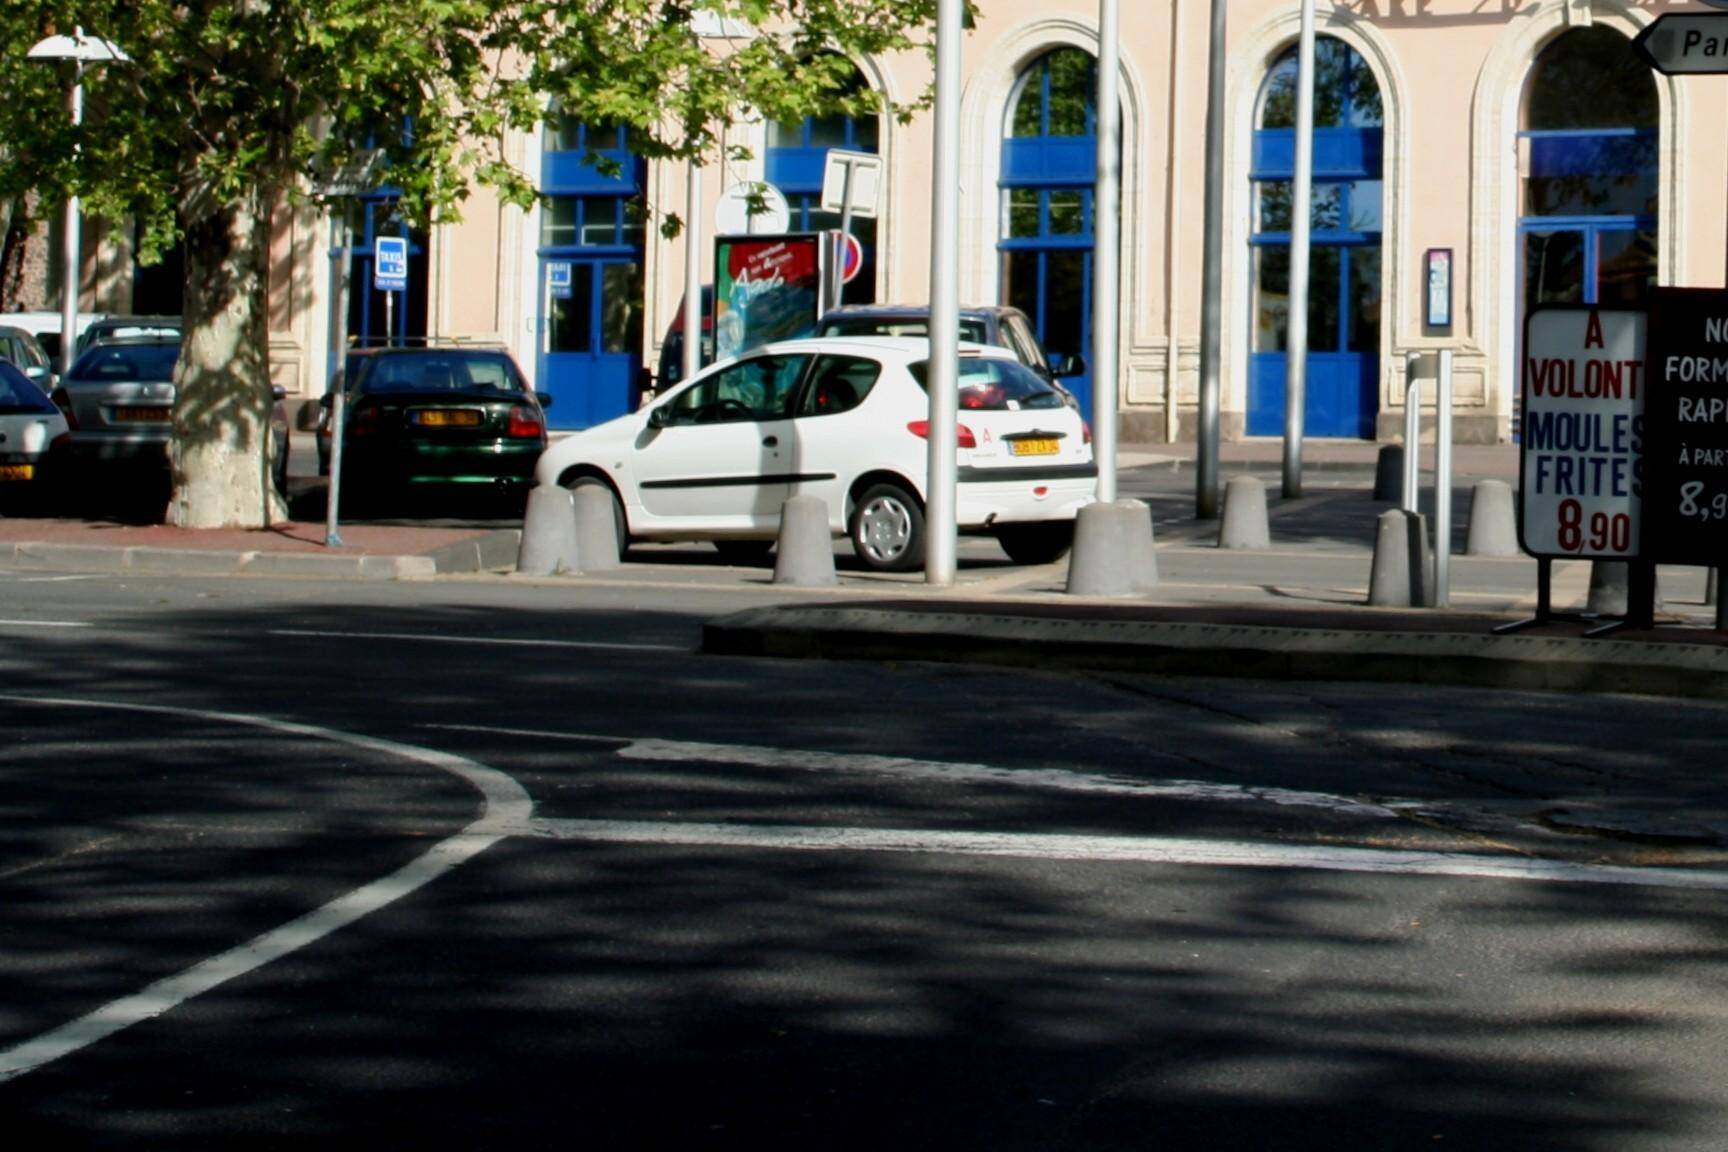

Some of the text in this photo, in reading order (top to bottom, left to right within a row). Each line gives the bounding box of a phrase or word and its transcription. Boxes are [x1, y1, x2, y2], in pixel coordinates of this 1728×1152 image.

[1529, 358, 1644, 400] VOLONT
[1527, 411, 1646, 454] MOULES
[1679, 442, 1690, 466] À
[1536, 455, 1644, 497] FRITES
[1558, 498, 1631, 555] 8,90
